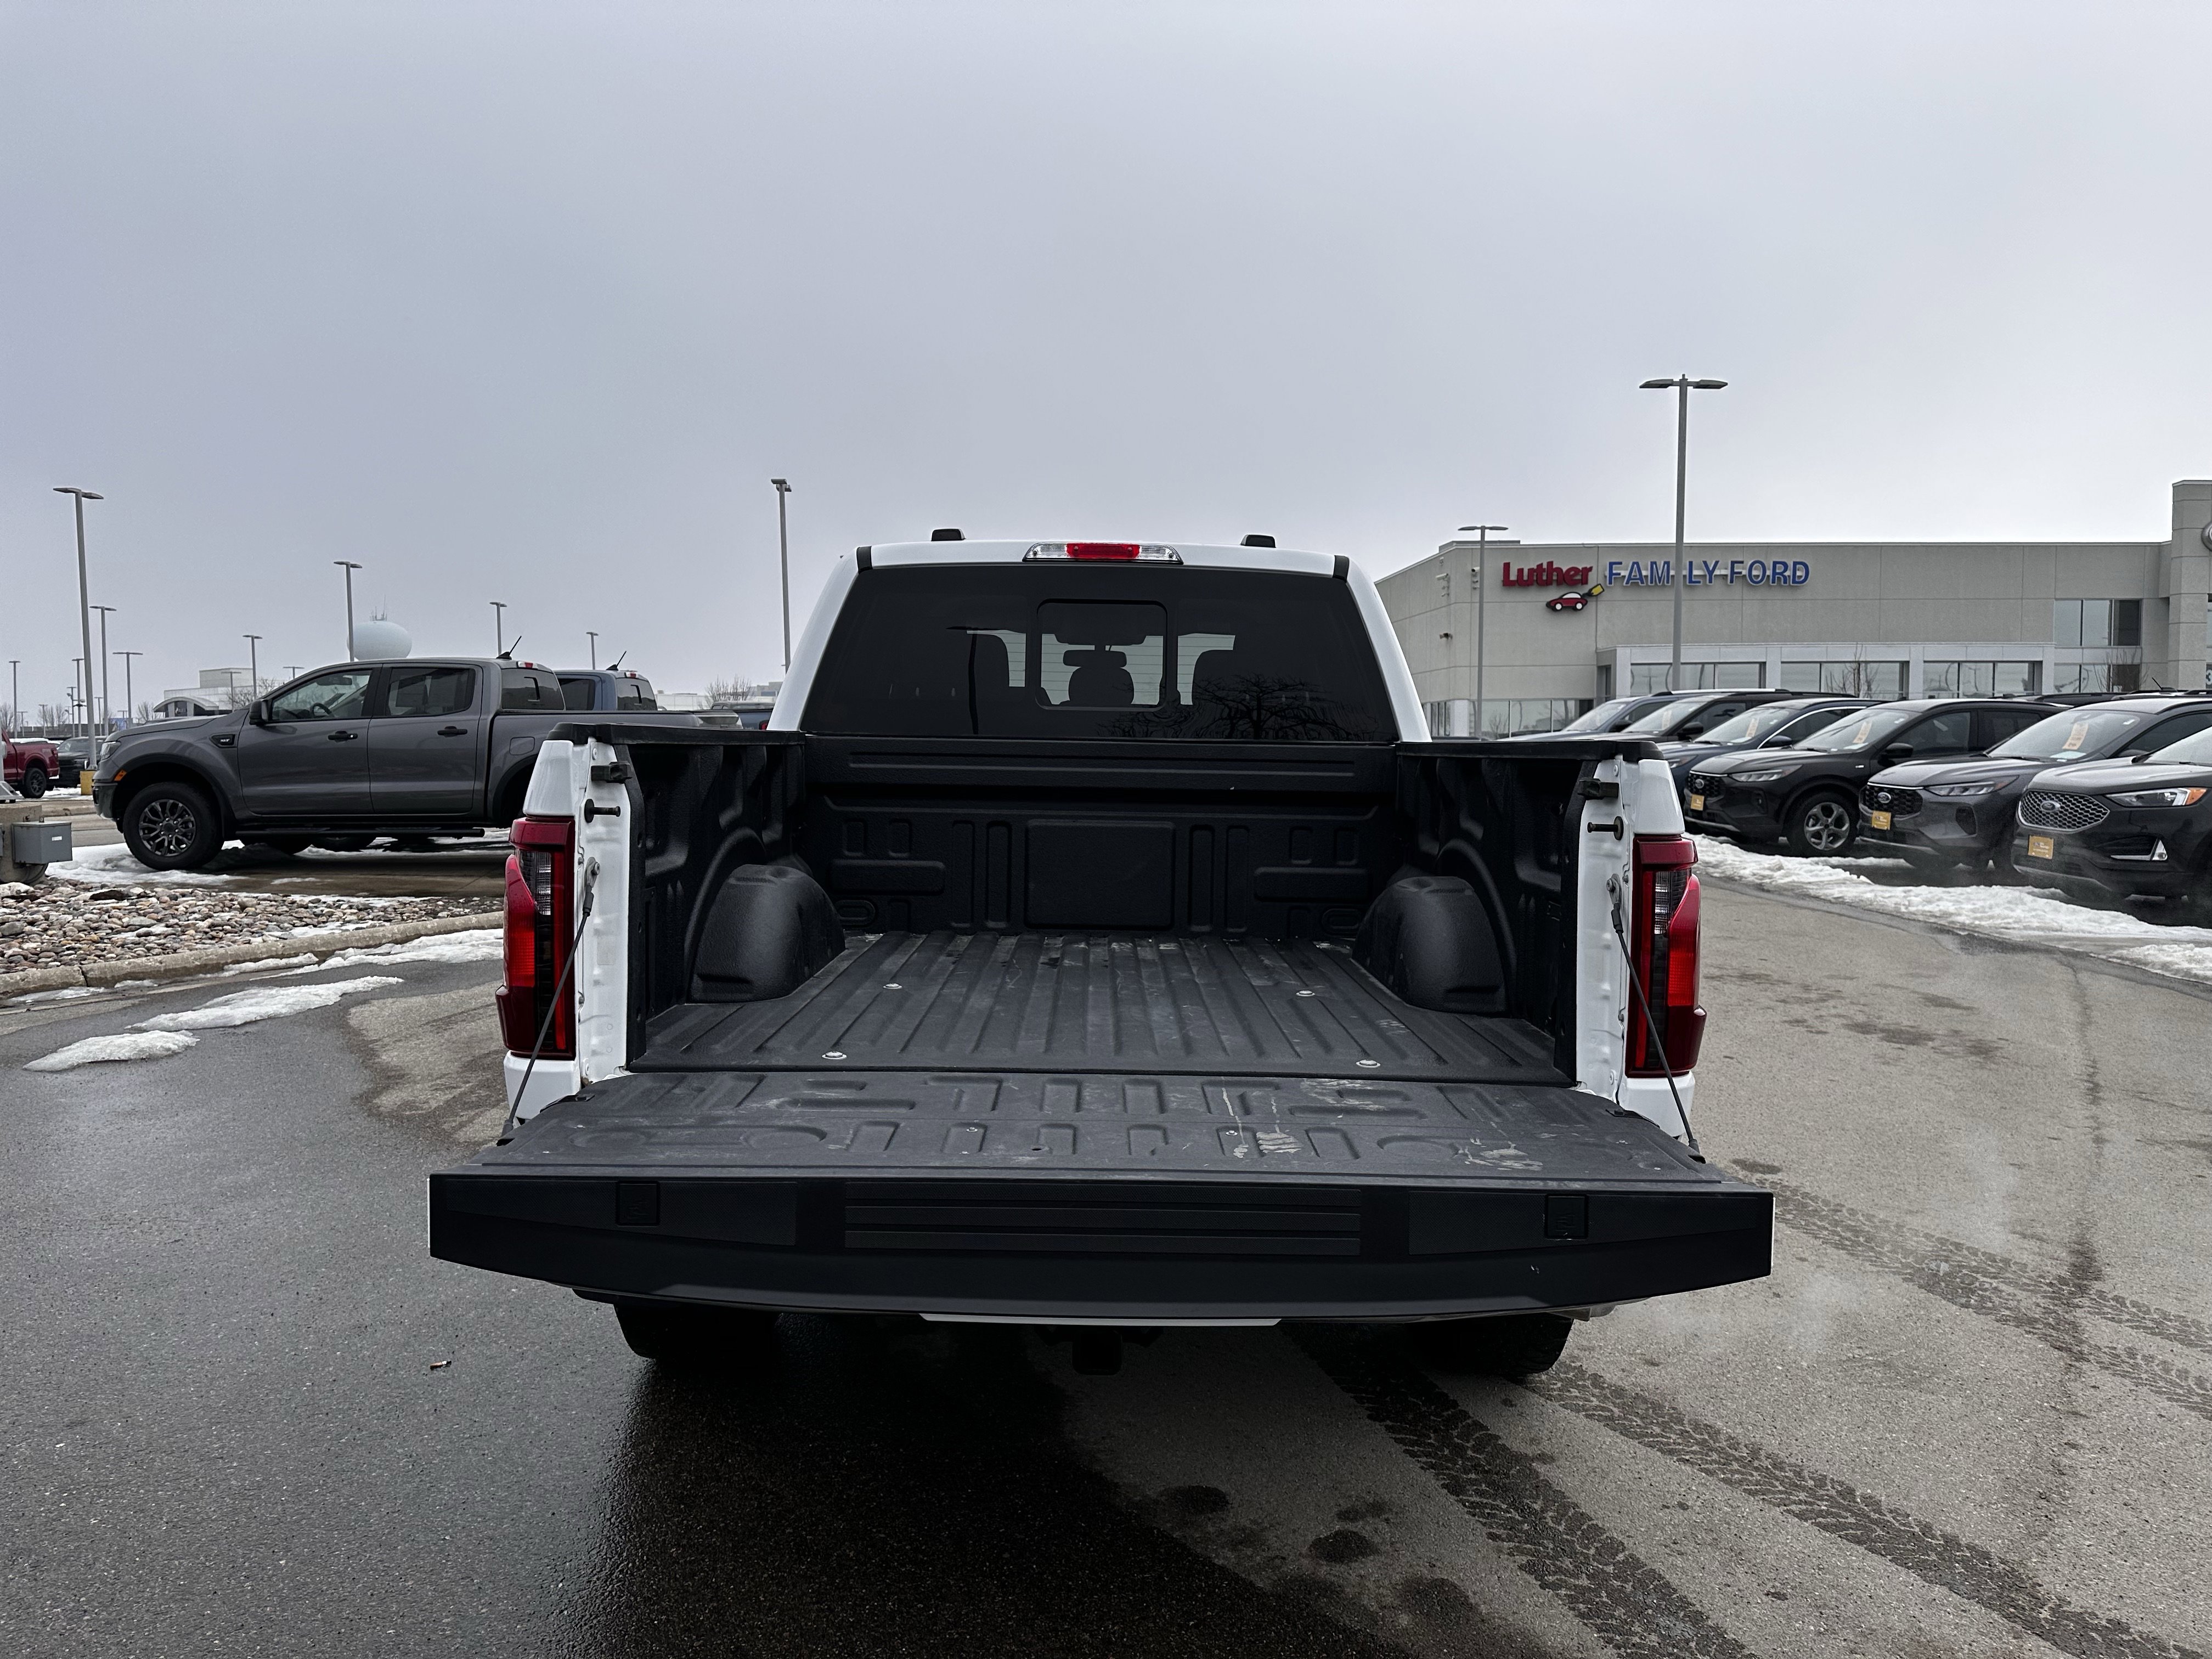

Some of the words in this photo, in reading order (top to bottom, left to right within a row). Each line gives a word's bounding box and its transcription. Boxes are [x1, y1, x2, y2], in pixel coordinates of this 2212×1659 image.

[1502, 561, 1593, 587] Luther
[1607, 560, 1720, 586] FAMLY
[1729, 560, 1810, 585] FORD
